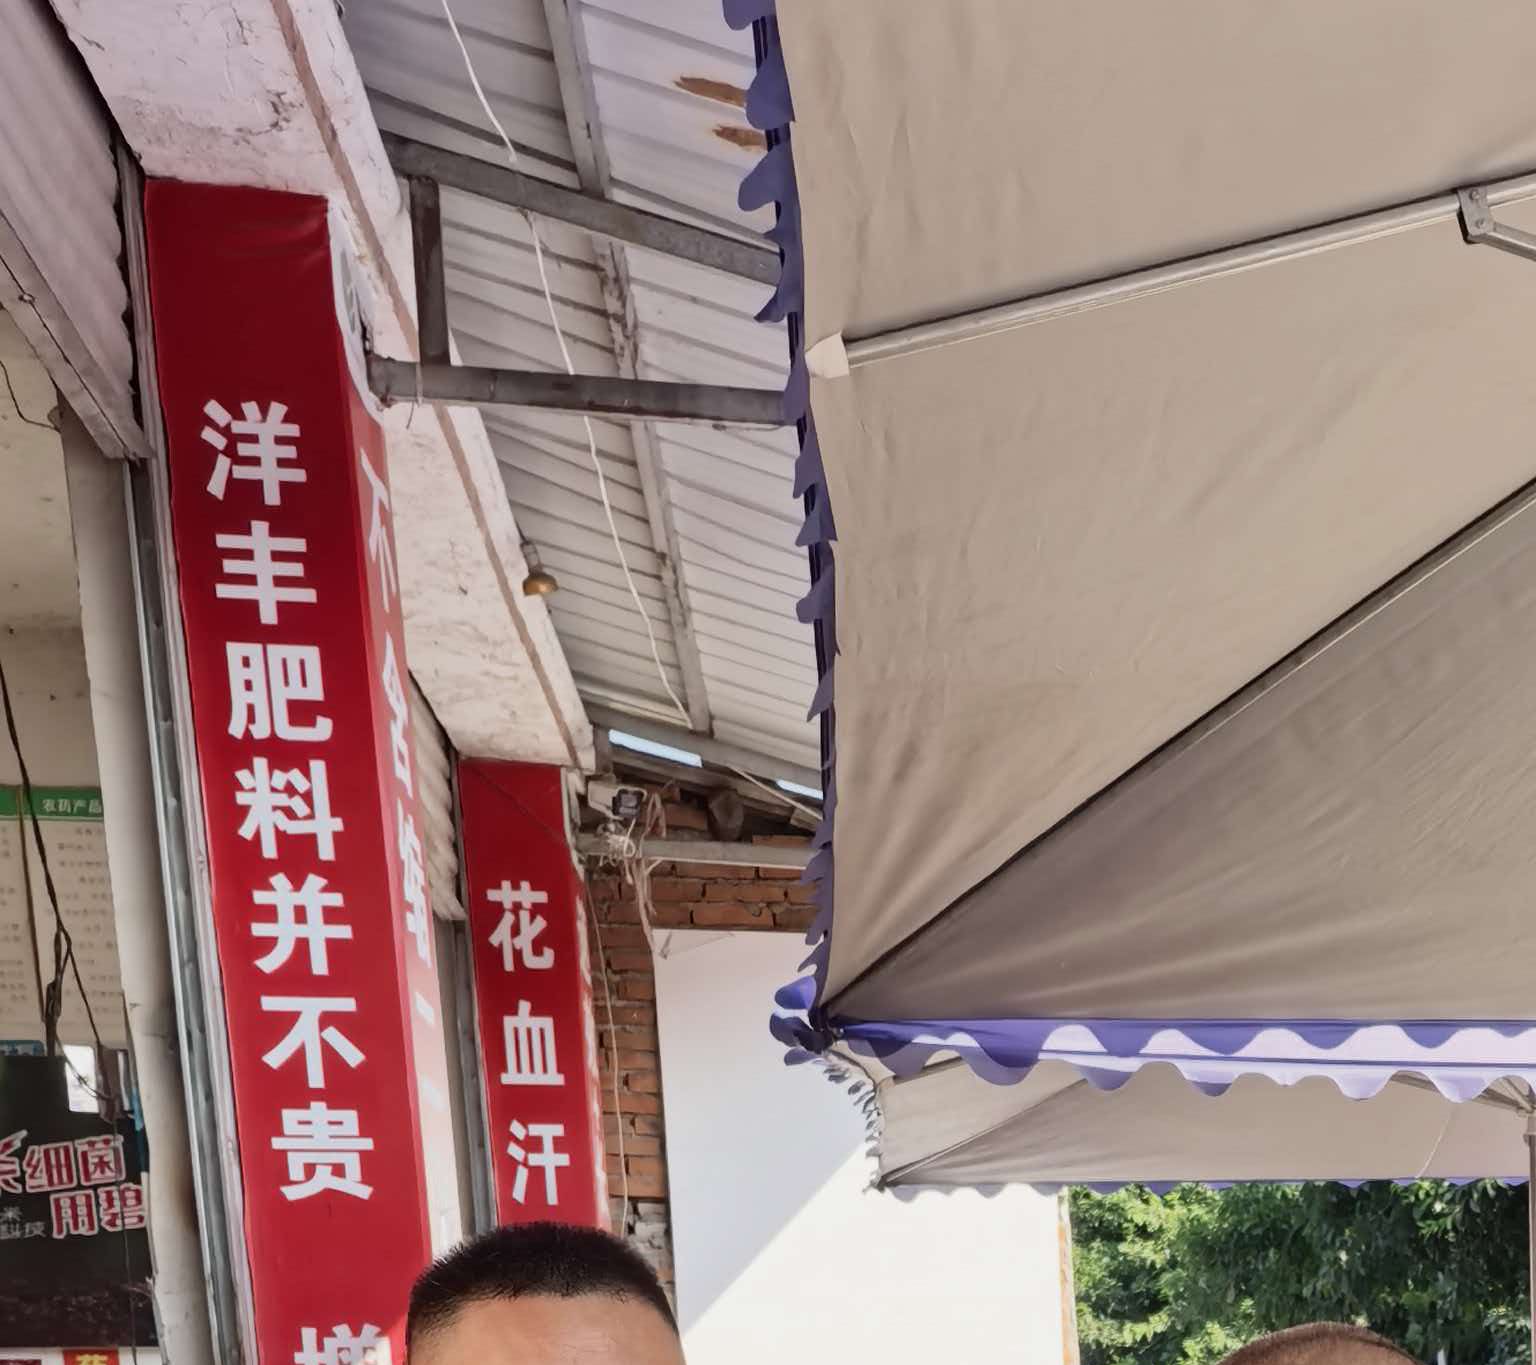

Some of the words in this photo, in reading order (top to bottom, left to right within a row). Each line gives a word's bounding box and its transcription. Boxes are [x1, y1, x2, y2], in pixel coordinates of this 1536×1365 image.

[201, 399, 374, 1202] 洋丰肥料并不贵
[486, 880, 570, 1205] 花血汗
